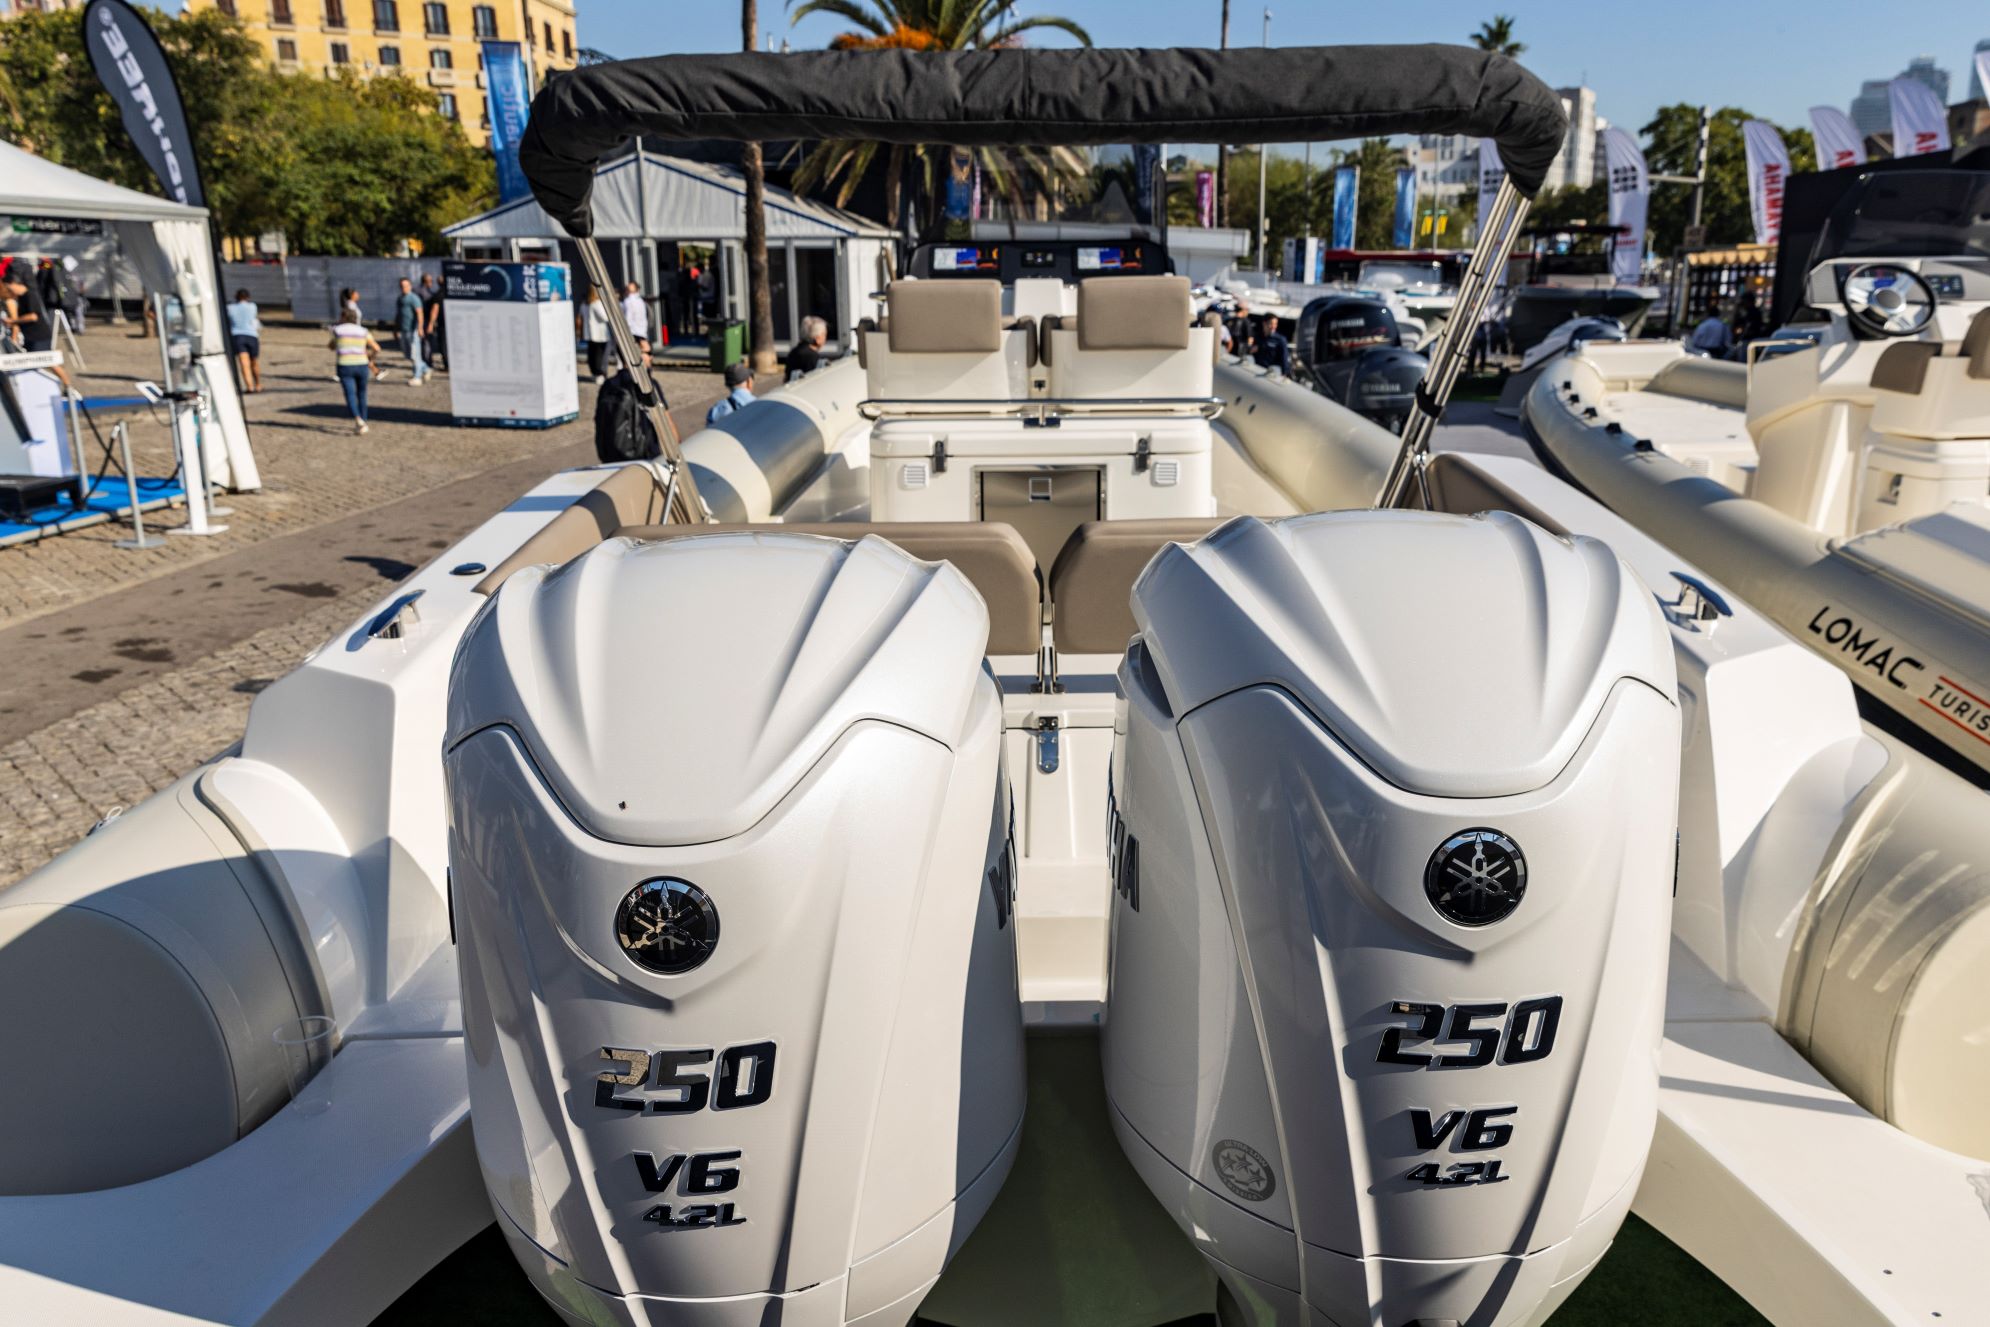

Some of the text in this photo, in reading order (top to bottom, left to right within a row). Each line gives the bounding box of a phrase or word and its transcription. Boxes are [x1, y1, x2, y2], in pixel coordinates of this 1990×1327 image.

[1808, 606, 1925, 690] LOMAC
[1375, 994, 1563, 1067] 250
[594, 1039, 776, 1112] 250
[1408, 1104, 1518, 1151] V6
[631, 1149, 742, 1193] V6
